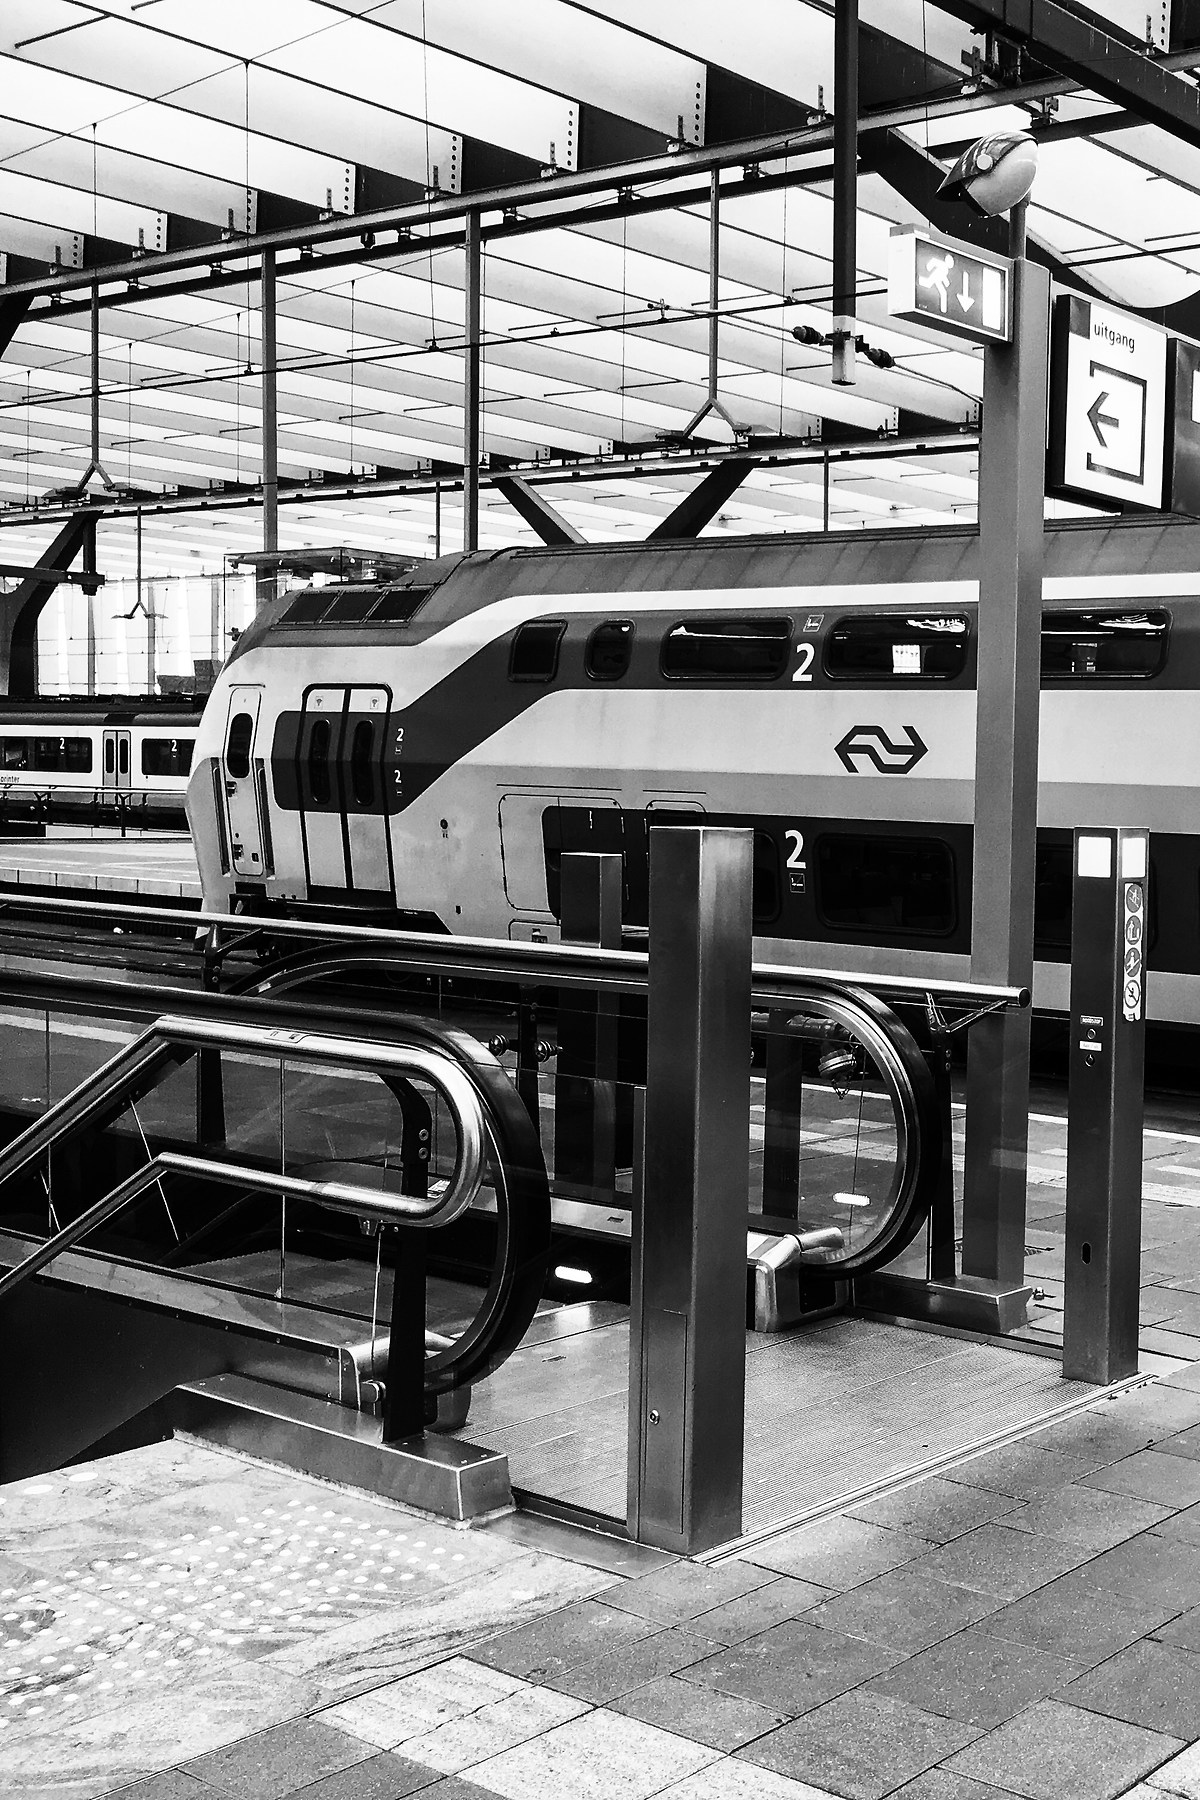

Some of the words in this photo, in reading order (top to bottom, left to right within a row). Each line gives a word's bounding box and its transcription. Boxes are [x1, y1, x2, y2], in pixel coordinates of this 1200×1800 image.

[1094, 322, 1135, 354] uitgang
[792, 642, 815, 682] 2
[396, 727, 404, 742] 2
[60, 737, 65, 750] 2
[171, 739, 178, 752] 2
[394, 769, 402, 783] 2
[784, 829, 806, 869] 2
